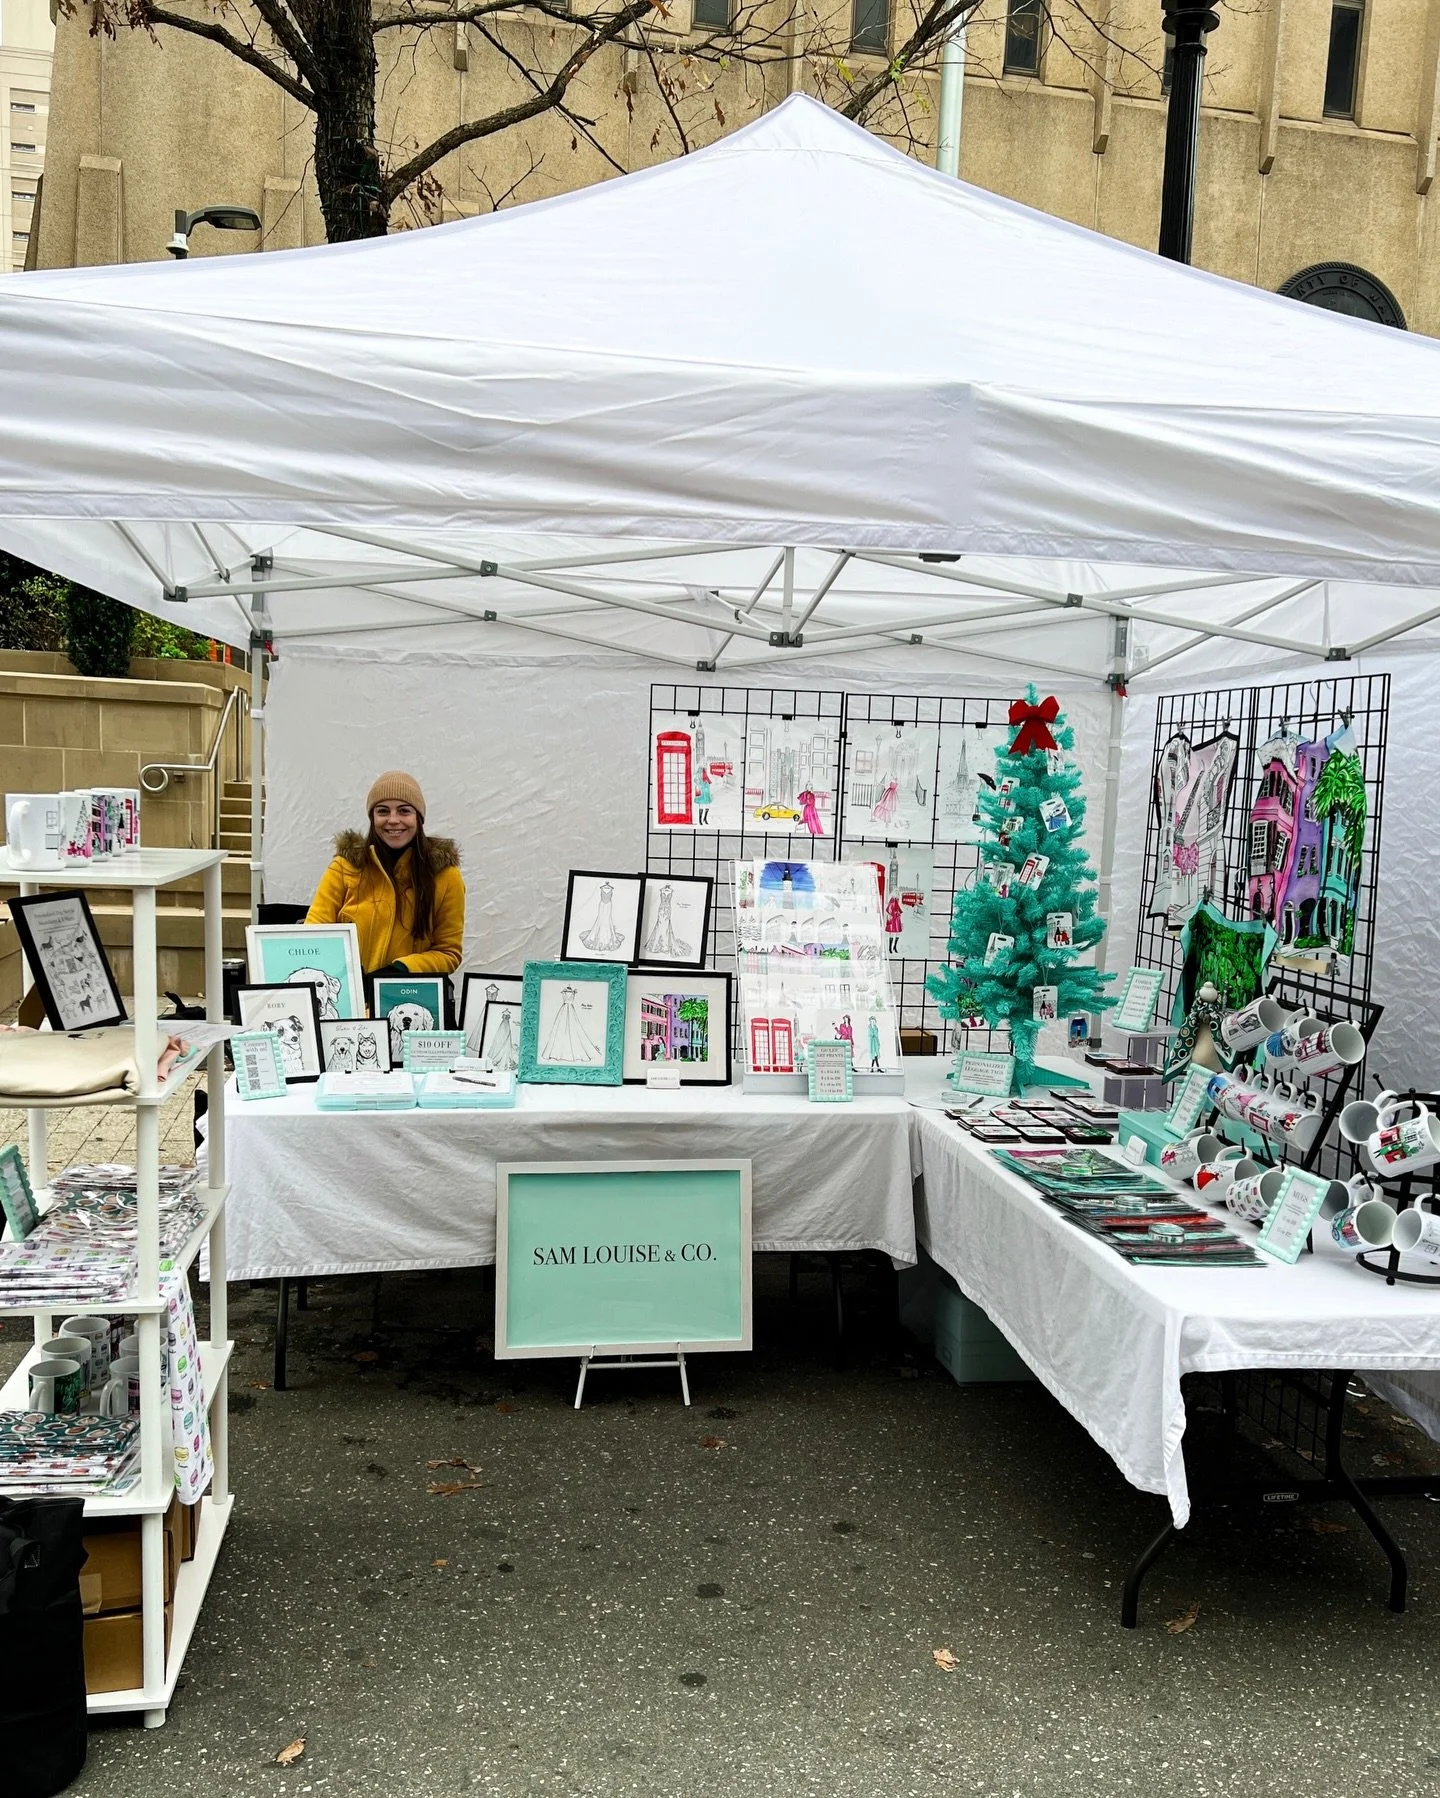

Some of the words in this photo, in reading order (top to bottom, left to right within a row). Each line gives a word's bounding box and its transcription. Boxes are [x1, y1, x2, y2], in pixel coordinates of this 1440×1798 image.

[1339, 275, 1359, 287] OF
[288, 947, 320, 957] CHLOE
[417, 1040, 432, 1049] $10
[433, 1040, 453, 1048] OFF
[965, 1060, 1006, 1069] PERSONALIZED
[533, 1245, 577, 1266] SAM
[583, 1244, 660, 1264] LOUISE
[664, 1249, 676, 1262] &
[681, 1243, 717, 1262] CO.
